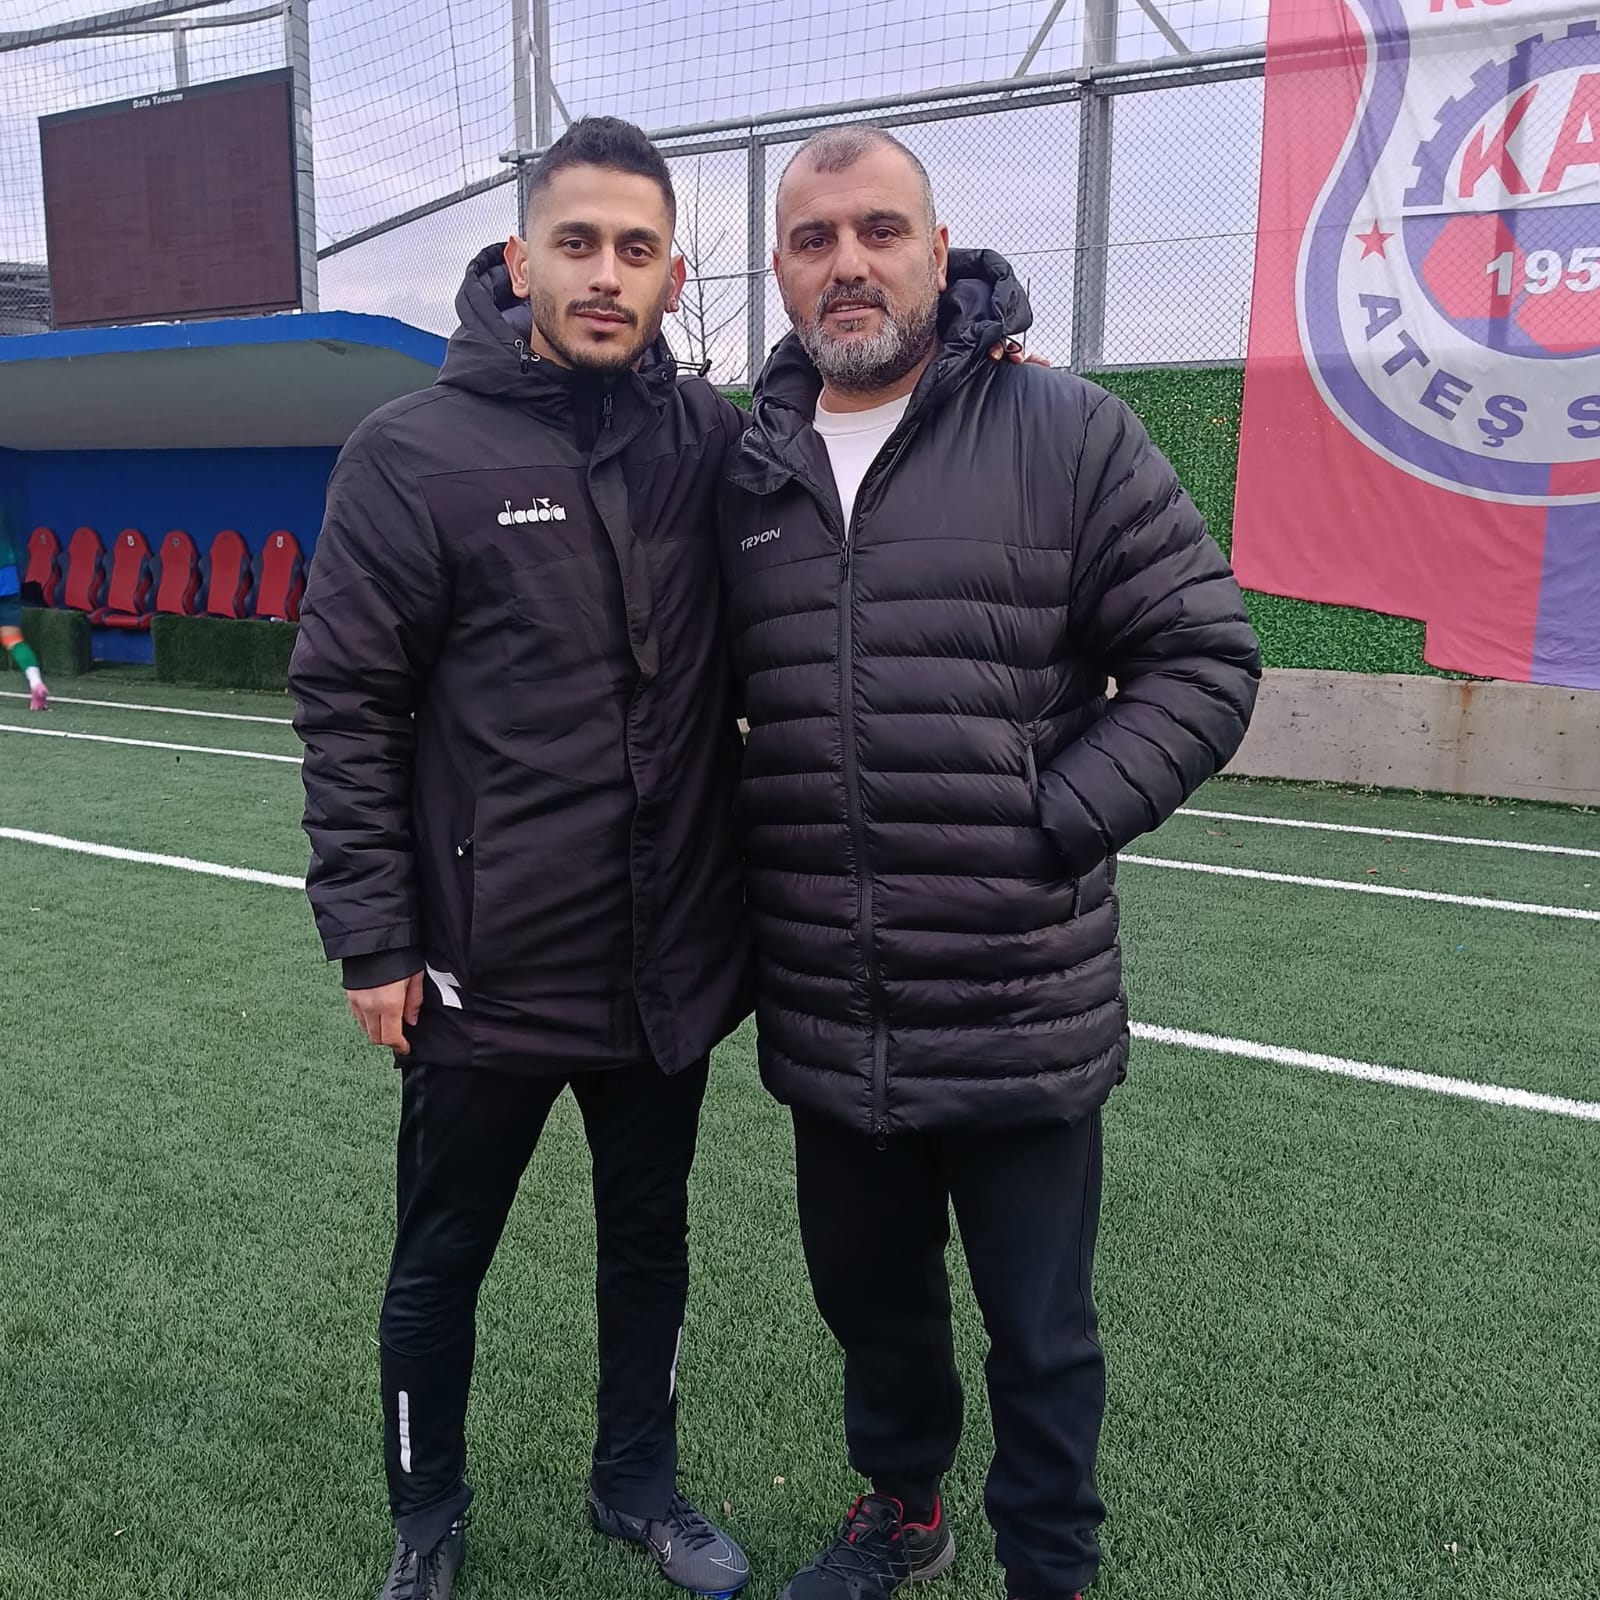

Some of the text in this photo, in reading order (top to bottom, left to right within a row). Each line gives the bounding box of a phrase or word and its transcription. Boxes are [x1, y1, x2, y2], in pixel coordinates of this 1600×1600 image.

[1358, 293, 1528, 448] ATEŞ
[497, 497, 567, 526] diadora
[740, 527, 781, 552] TRYON
